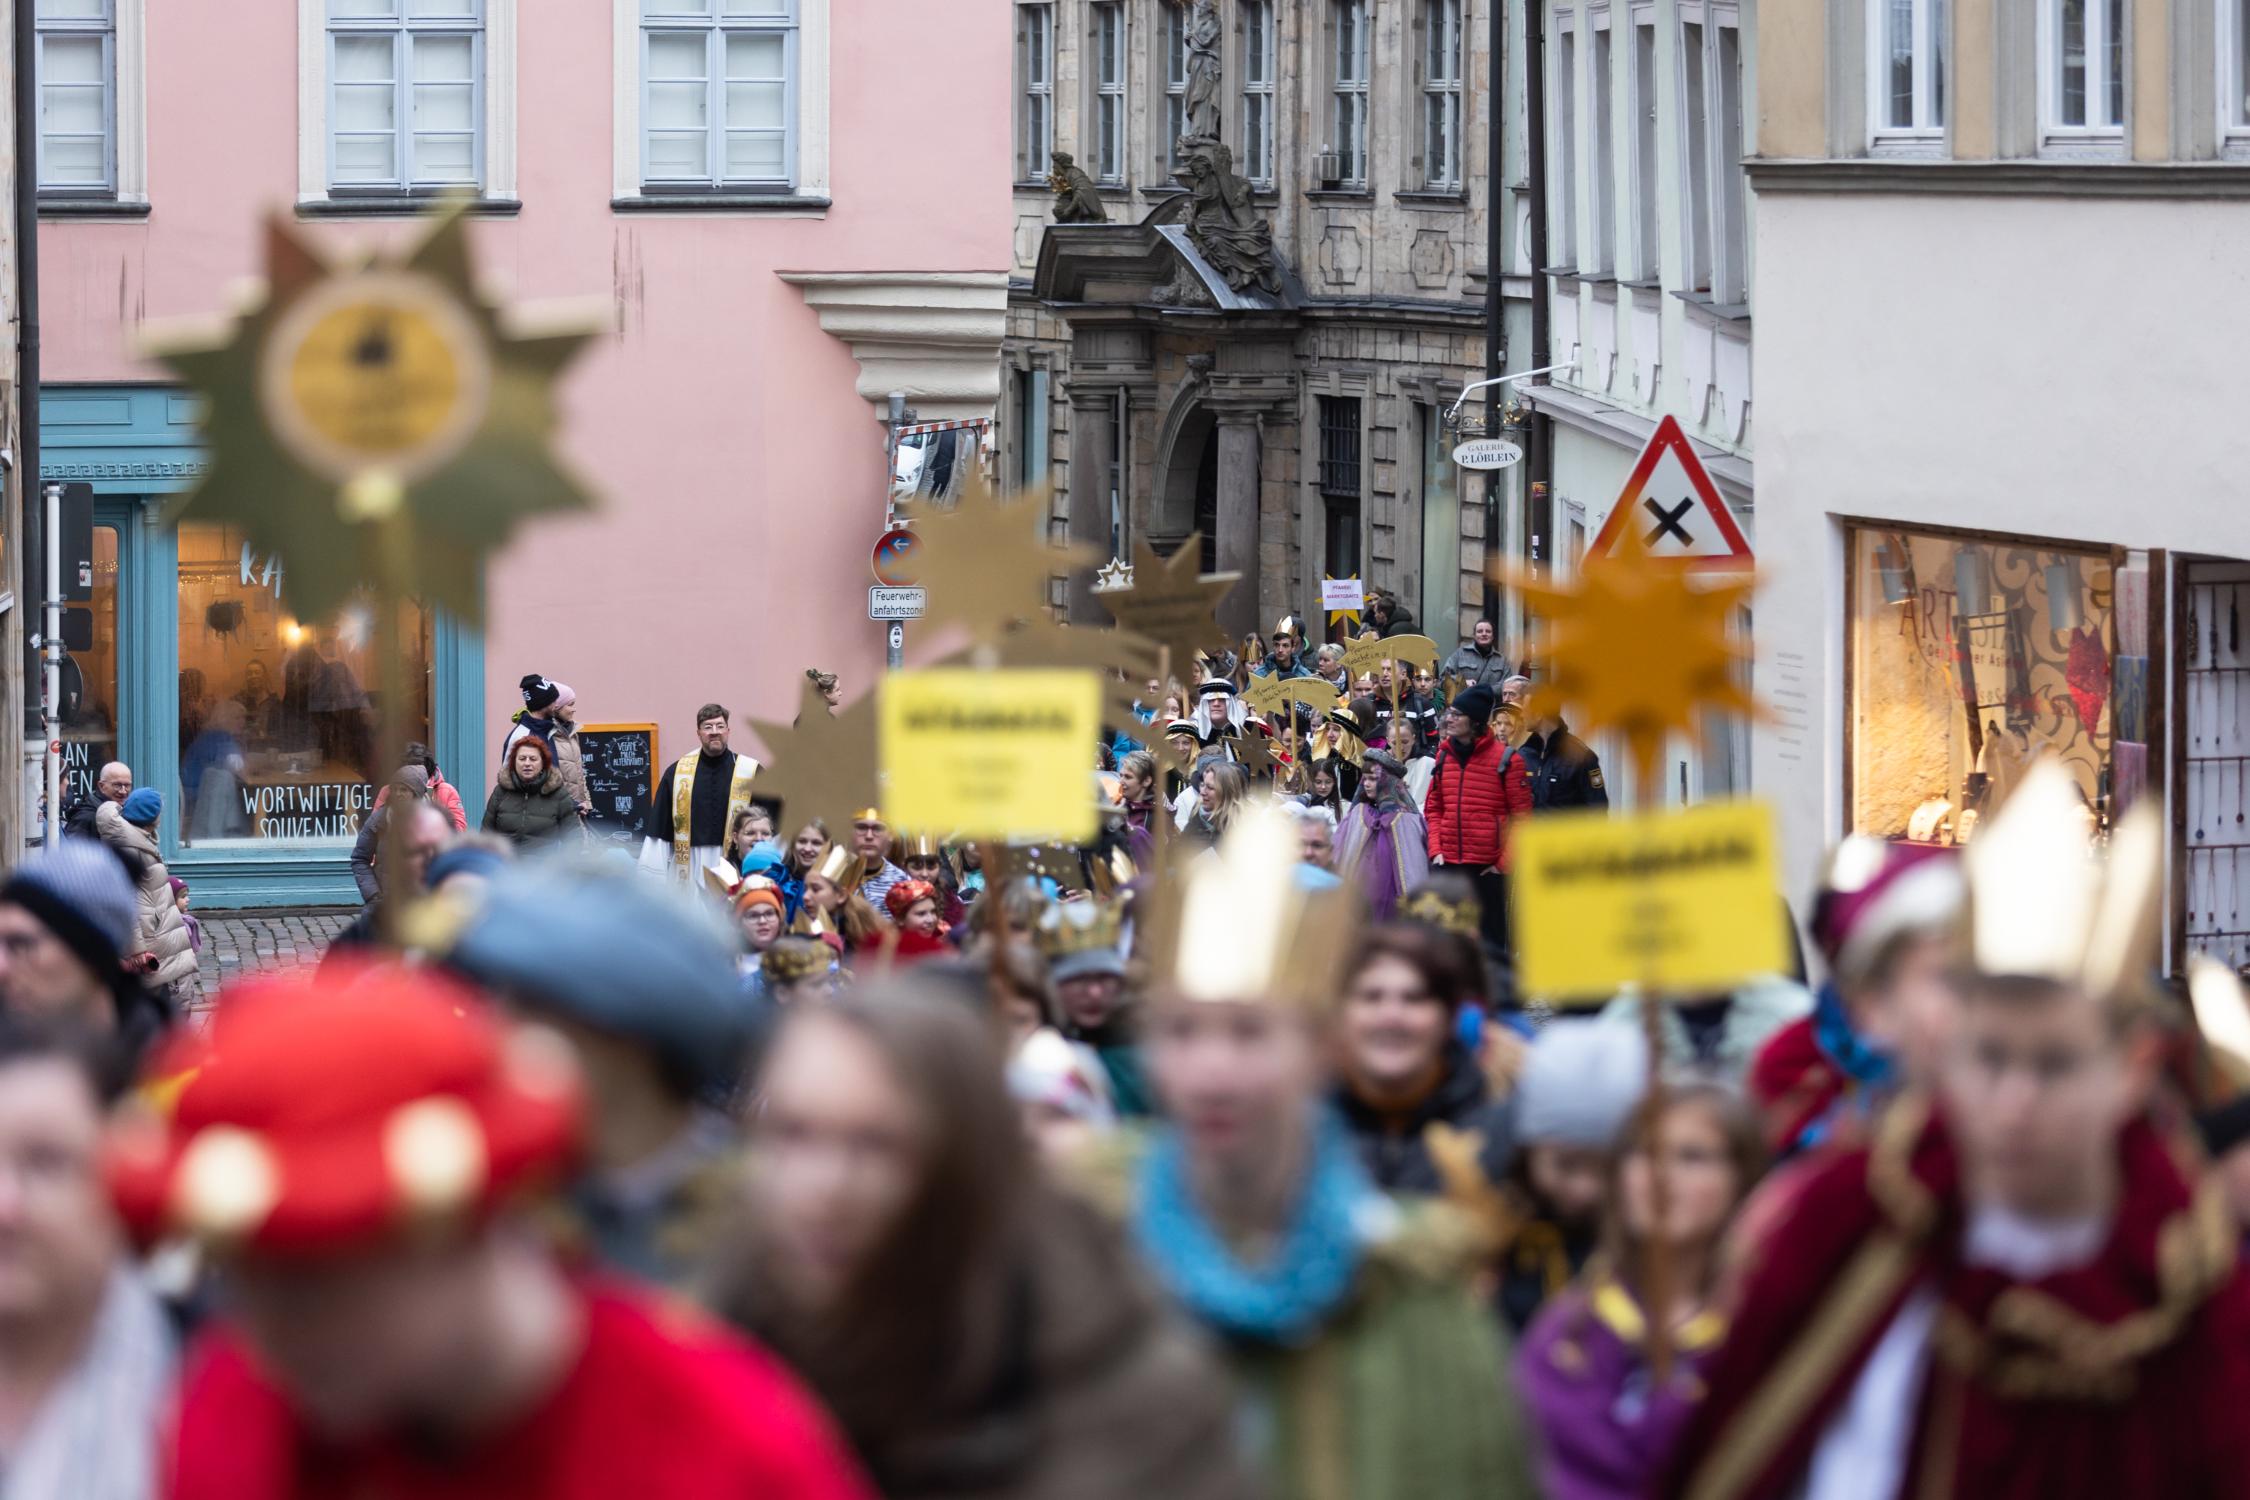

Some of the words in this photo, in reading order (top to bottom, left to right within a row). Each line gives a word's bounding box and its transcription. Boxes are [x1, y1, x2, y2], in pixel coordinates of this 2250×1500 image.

[1467, 443, 1505, 452] GALERIE
[875, 590, 923, 601] Feuerwehr-
[873, 605, 926, 615] anfahrtszone
[243, 784, 373, 815] WORTWITZIGE
[260, 814, 359, 839] SOUVENIRS
